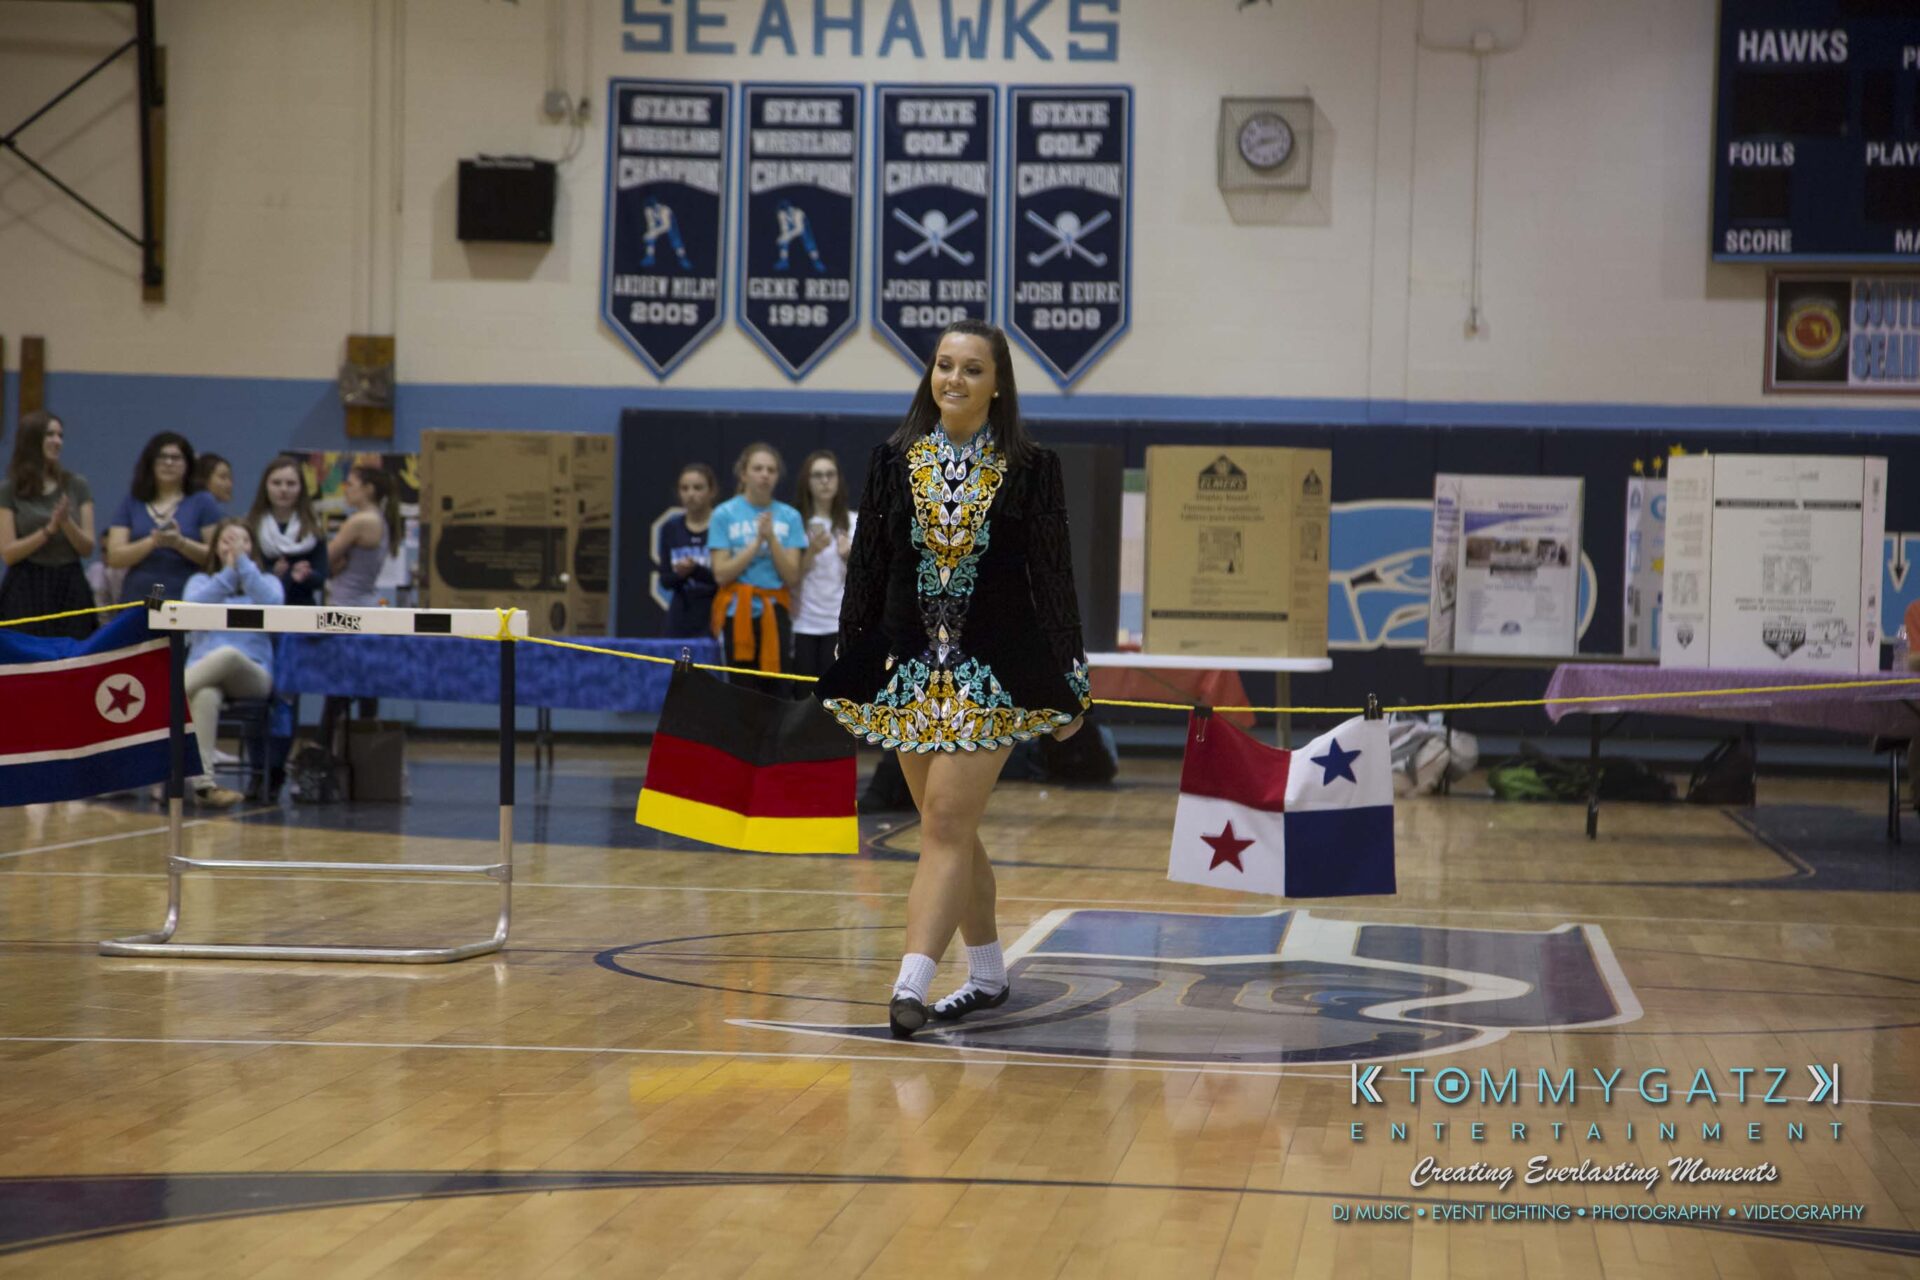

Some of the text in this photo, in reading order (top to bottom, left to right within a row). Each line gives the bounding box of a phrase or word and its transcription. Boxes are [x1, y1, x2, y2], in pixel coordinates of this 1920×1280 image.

[621, 0, 1120, 61] SEAHAWKS
[1737, 29, 1849, 63] HAWKS
[631, 95, 711, 122] STATE
[763, 98, 843, 126] STATE
[897, 101, 977, 126] STATE
[1030, 102, 1110, 127] STATE
[904, 131, 970, 156] GOLF
[1036, 132, 1103, 158] GOLF
[1728, 142, 1795, 166] FOULS
[1865, 142, 1920, 166] PLAY
[884, 161, 988, 199] CHAMPION
[1017, 163, 1121, 199] CHAMPION
[1725, 229, 1792, 253] SCORE
[748, 277, 851, 301] GENE REID
[883, 279, 931, 300] JOSH
[1016, 281, 1065, 302] JOSH
[630, 302, 699, 326] 2005
[768, 304, 830, 327] 1996
[1033, 308, 1102, 330] 2008
[316, 611, 362, 631] BLAZER
